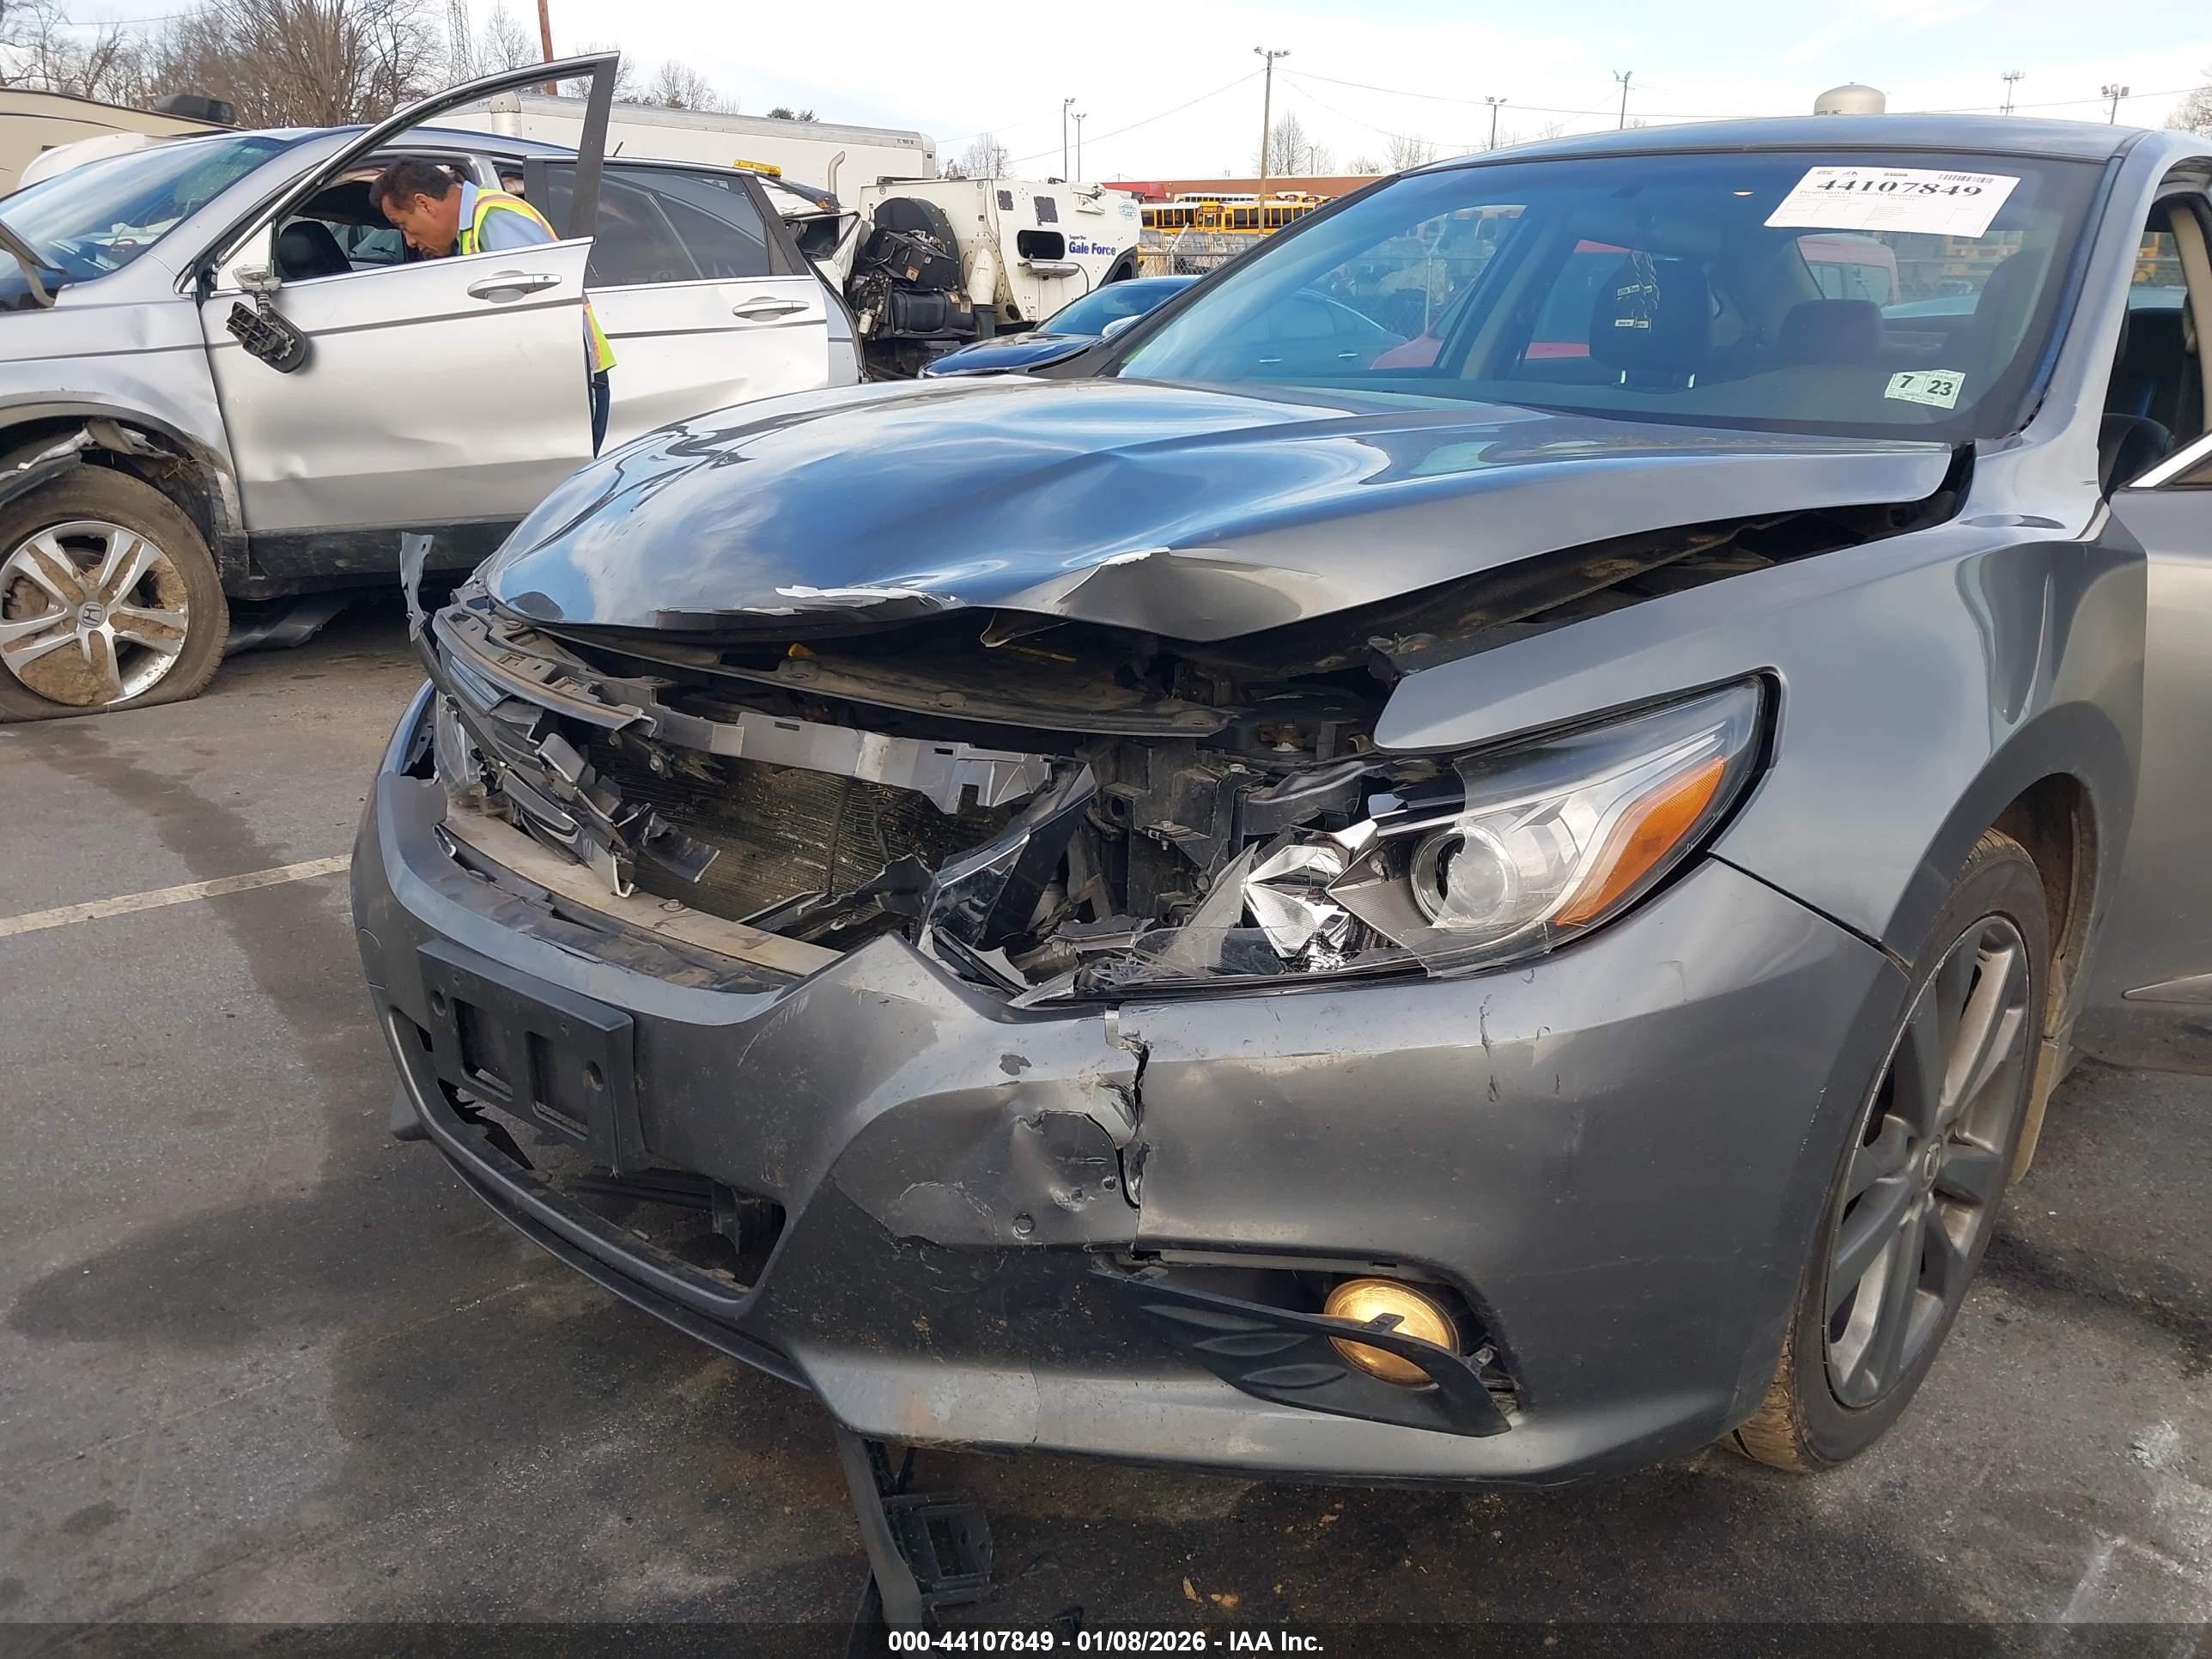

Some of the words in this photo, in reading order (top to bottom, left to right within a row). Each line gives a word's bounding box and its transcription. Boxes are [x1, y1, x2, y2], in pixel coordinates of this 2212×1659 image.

[1817, 179, 1982, 197] 44107849
[1068, 241, 1090, 254] Gale
[1091, 242, 1116, 256] Force
[1899, 375, 1915, 389] 7
[1927, 380, 1953, 396] 23
